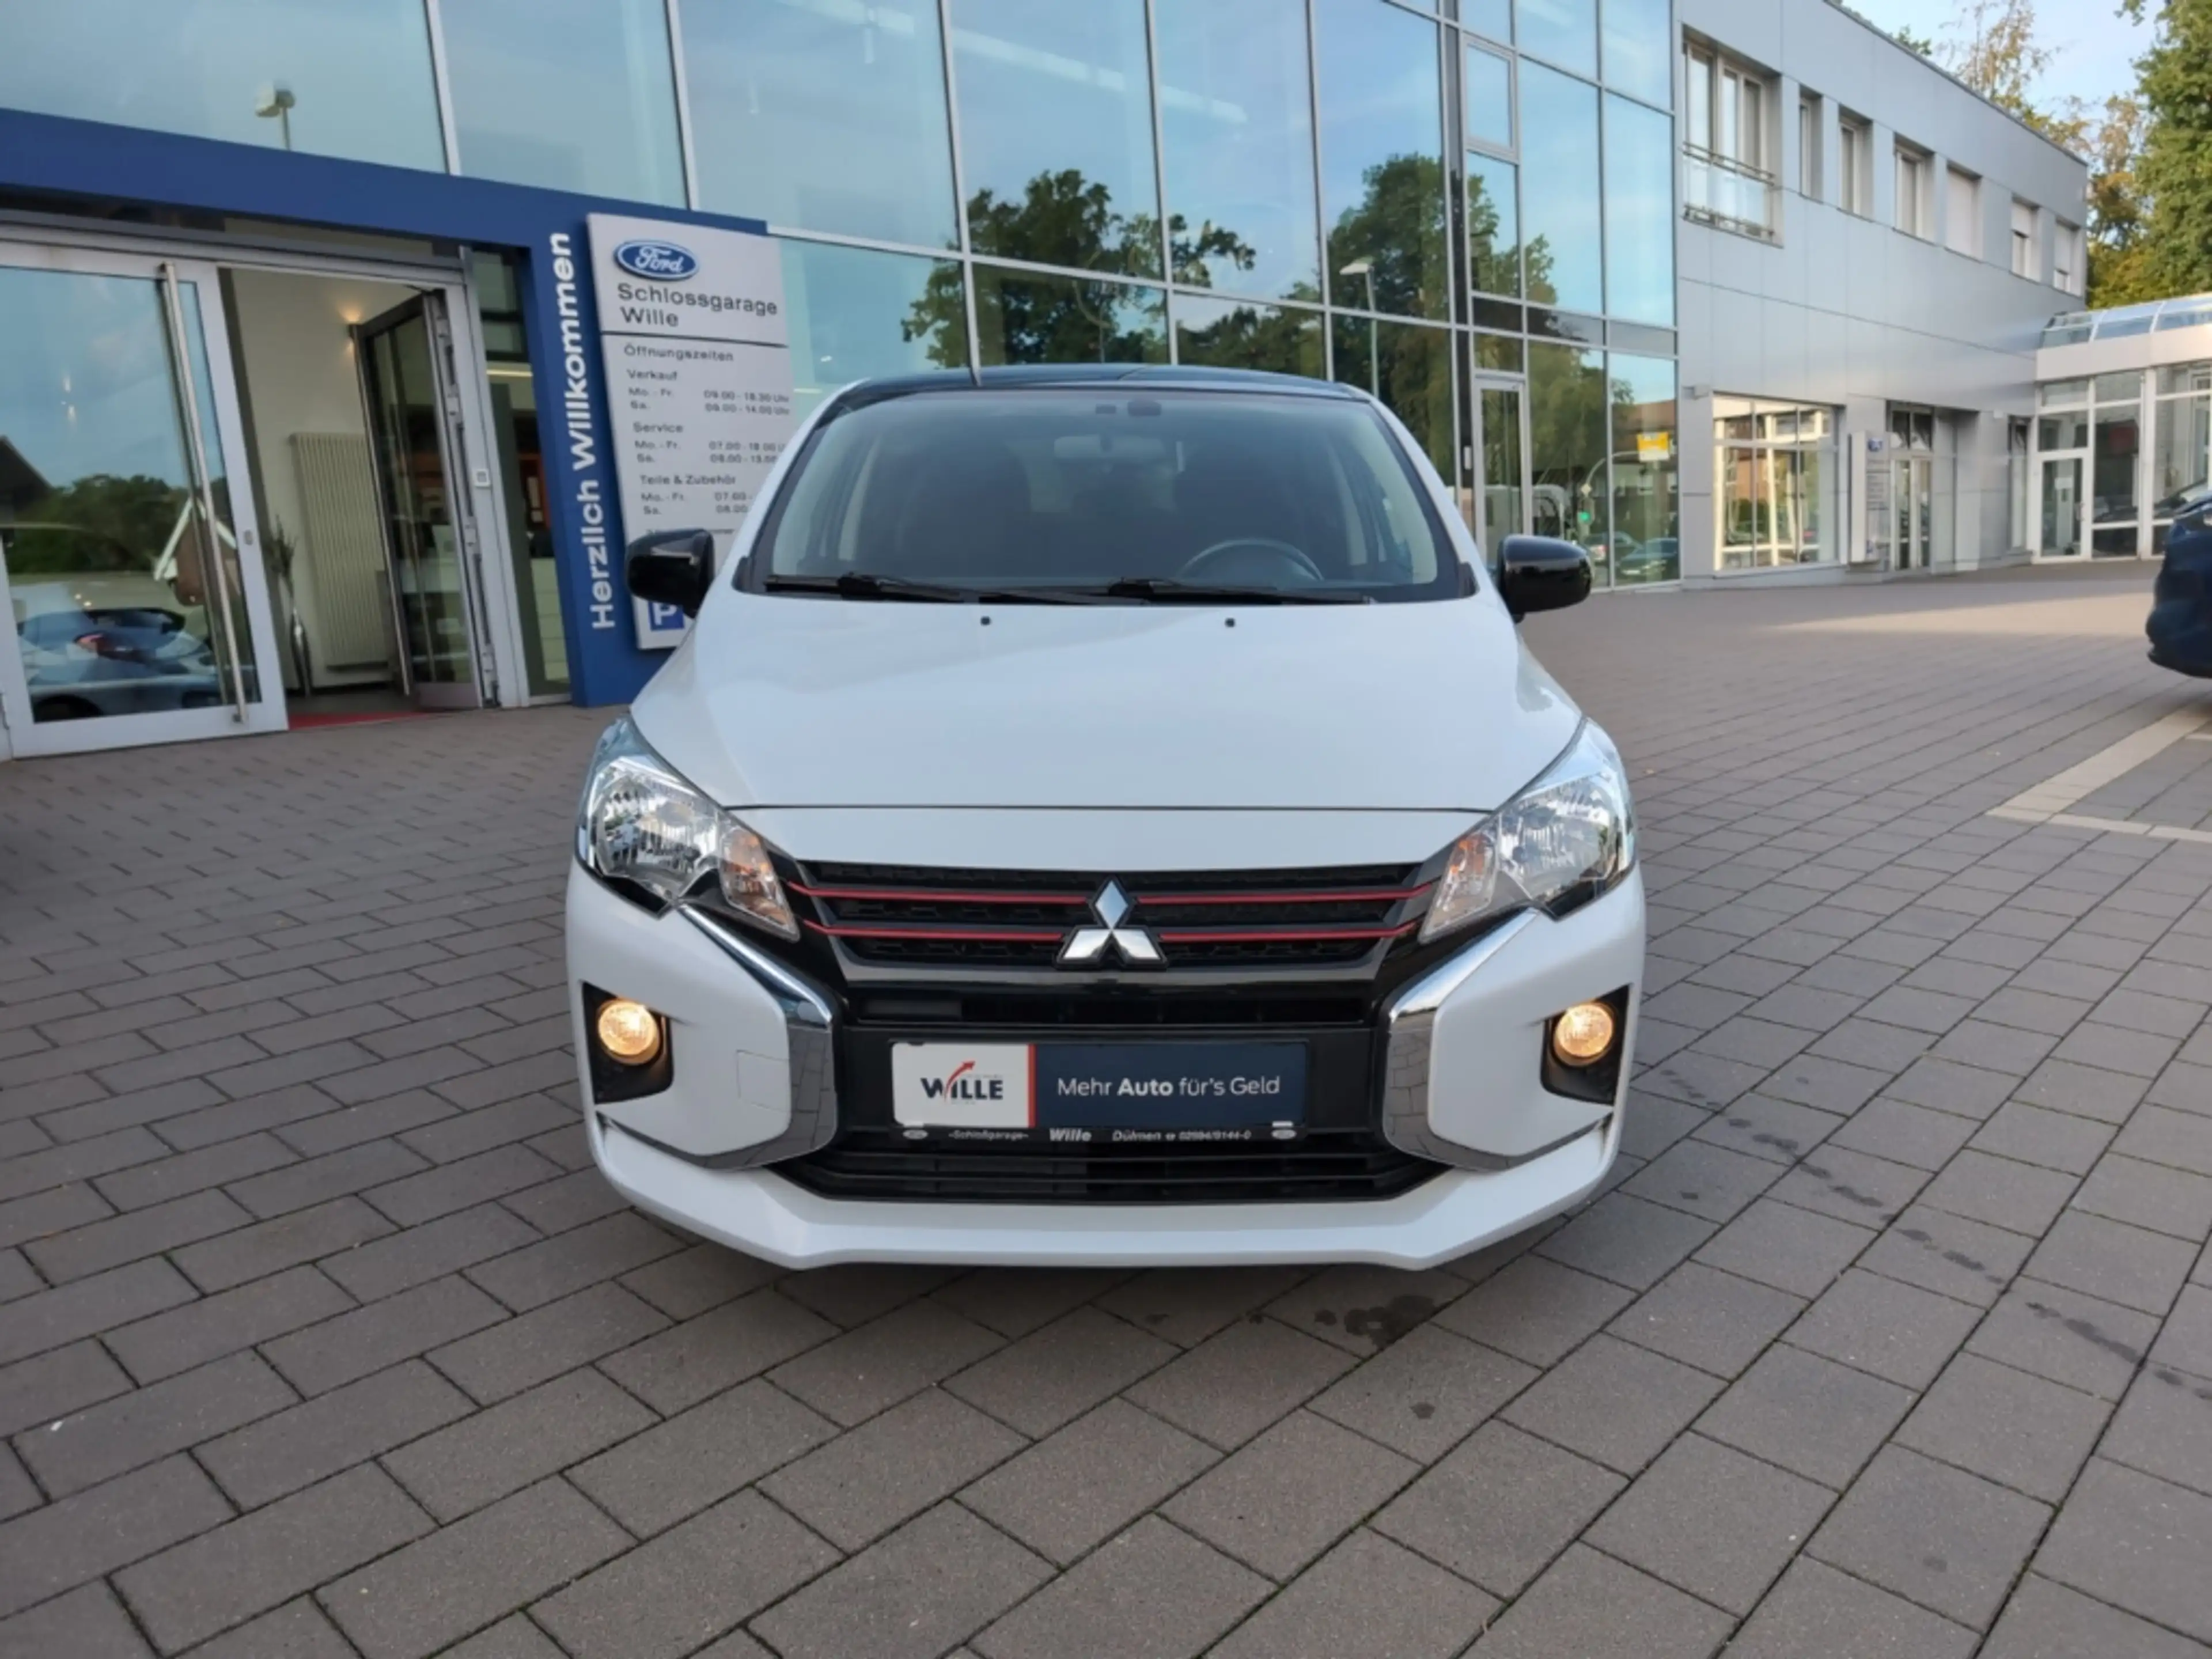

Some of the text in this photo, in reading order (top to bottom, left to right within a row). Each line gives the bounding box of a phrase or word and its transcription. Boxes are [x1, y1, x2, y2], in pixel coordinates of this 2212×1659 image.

[635, 245, 684, 274] Ford
[618, 282, 778, 317] Schlossgarage
[620, 306, 679, 327] Wille
[624, 342, 733, 362] Öffnungszeiten
[626, 369, 677, 381] Verkauf
[549, 232, 616, 630] Herzlich Willkommen
[633, 421, 684, 433] Service
[639, 473, 736, 485] Teile & Zubehör
[653, 603, 676, 625] P
[920, 1077, 1003, 1100] WILLE
[1057, 1074, 1281, 1096] Mehr Auto für's Geld
[1049, 1127, 1092, 1142] Wille
[1112, 1128, 1161, 1142] Dülmen
